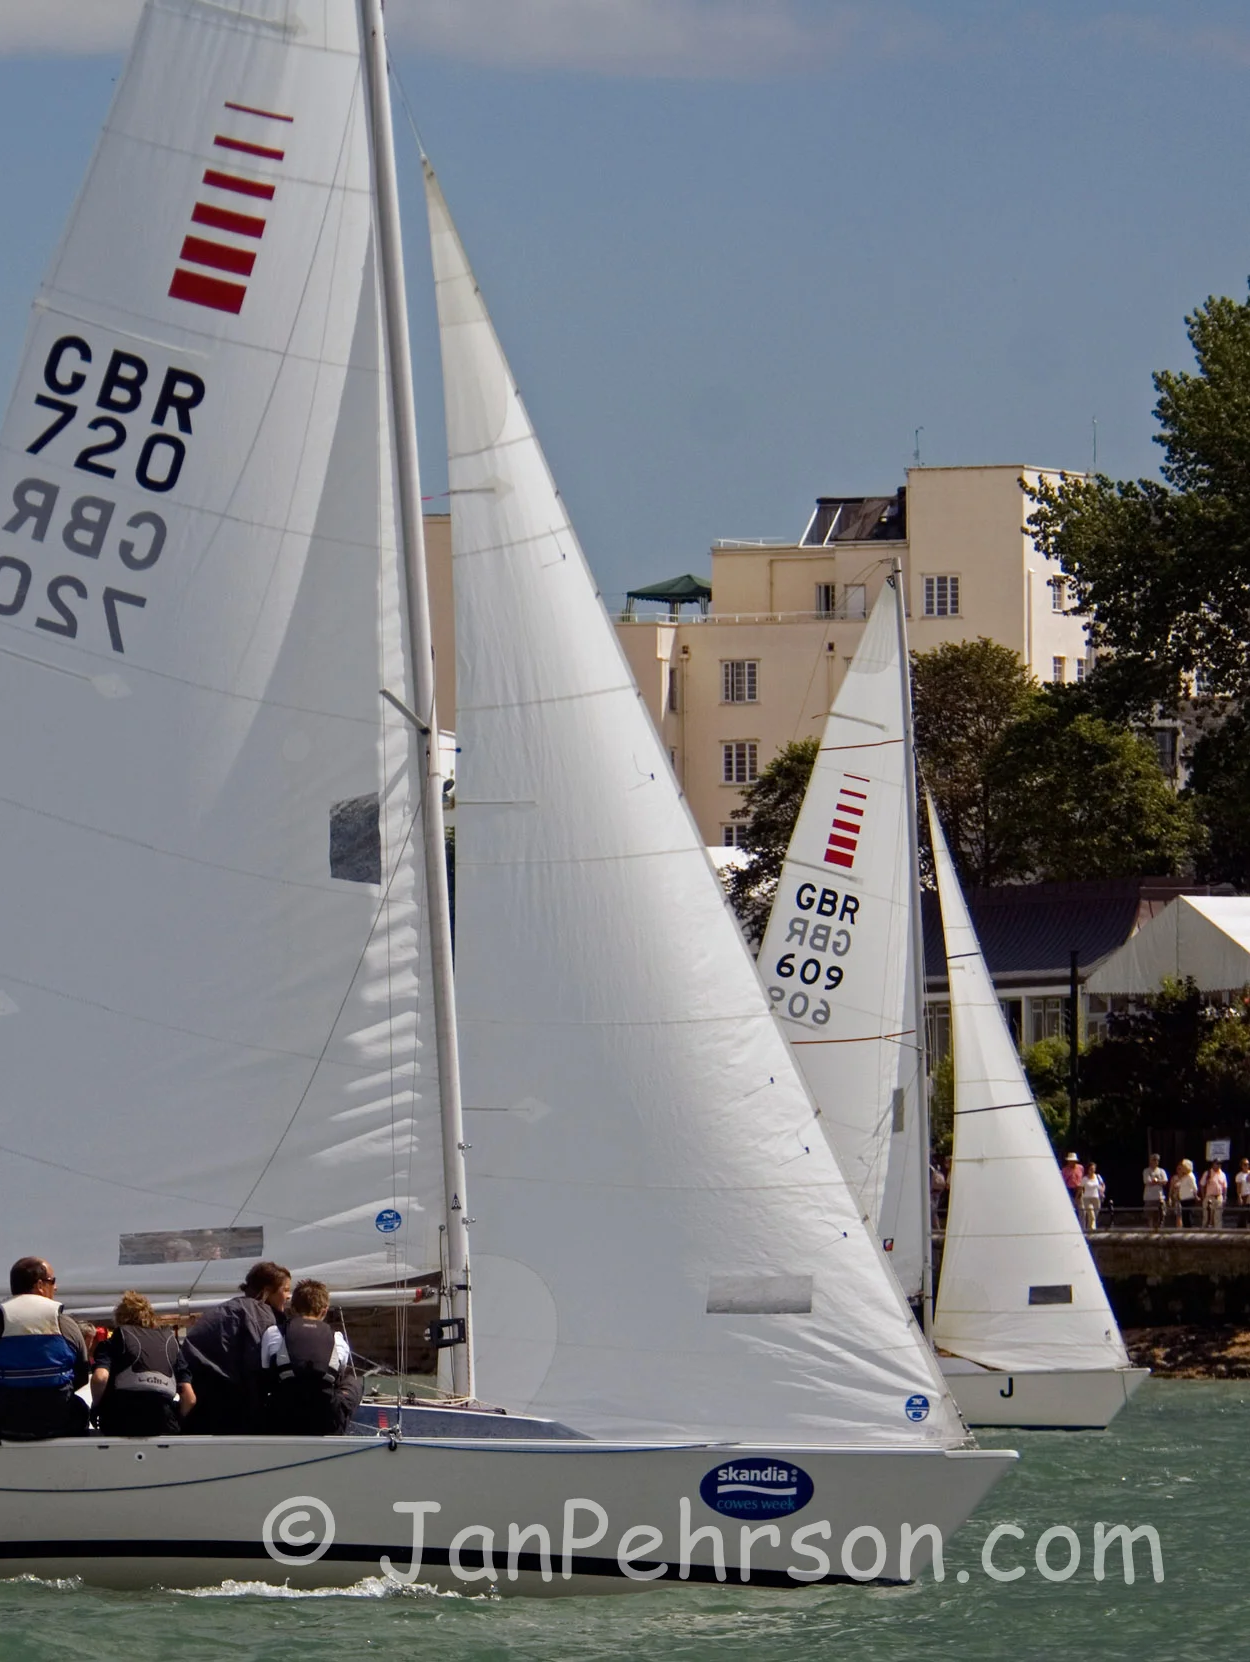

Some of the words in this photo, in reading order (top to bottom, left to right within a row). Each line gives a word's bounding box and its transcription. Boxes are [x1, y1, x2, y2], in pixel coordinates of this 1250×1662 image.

[44, 335, 206, 435] GBR
[25, 393, 186, 493] 720
[795, 882, 860, 925] GBR
[775, 953, 844, 990] 609
[999, 1376, 1014, 1399] J
[716, 1499, 758, 1510] cowes
[760, 1497, 795, 1510] week
